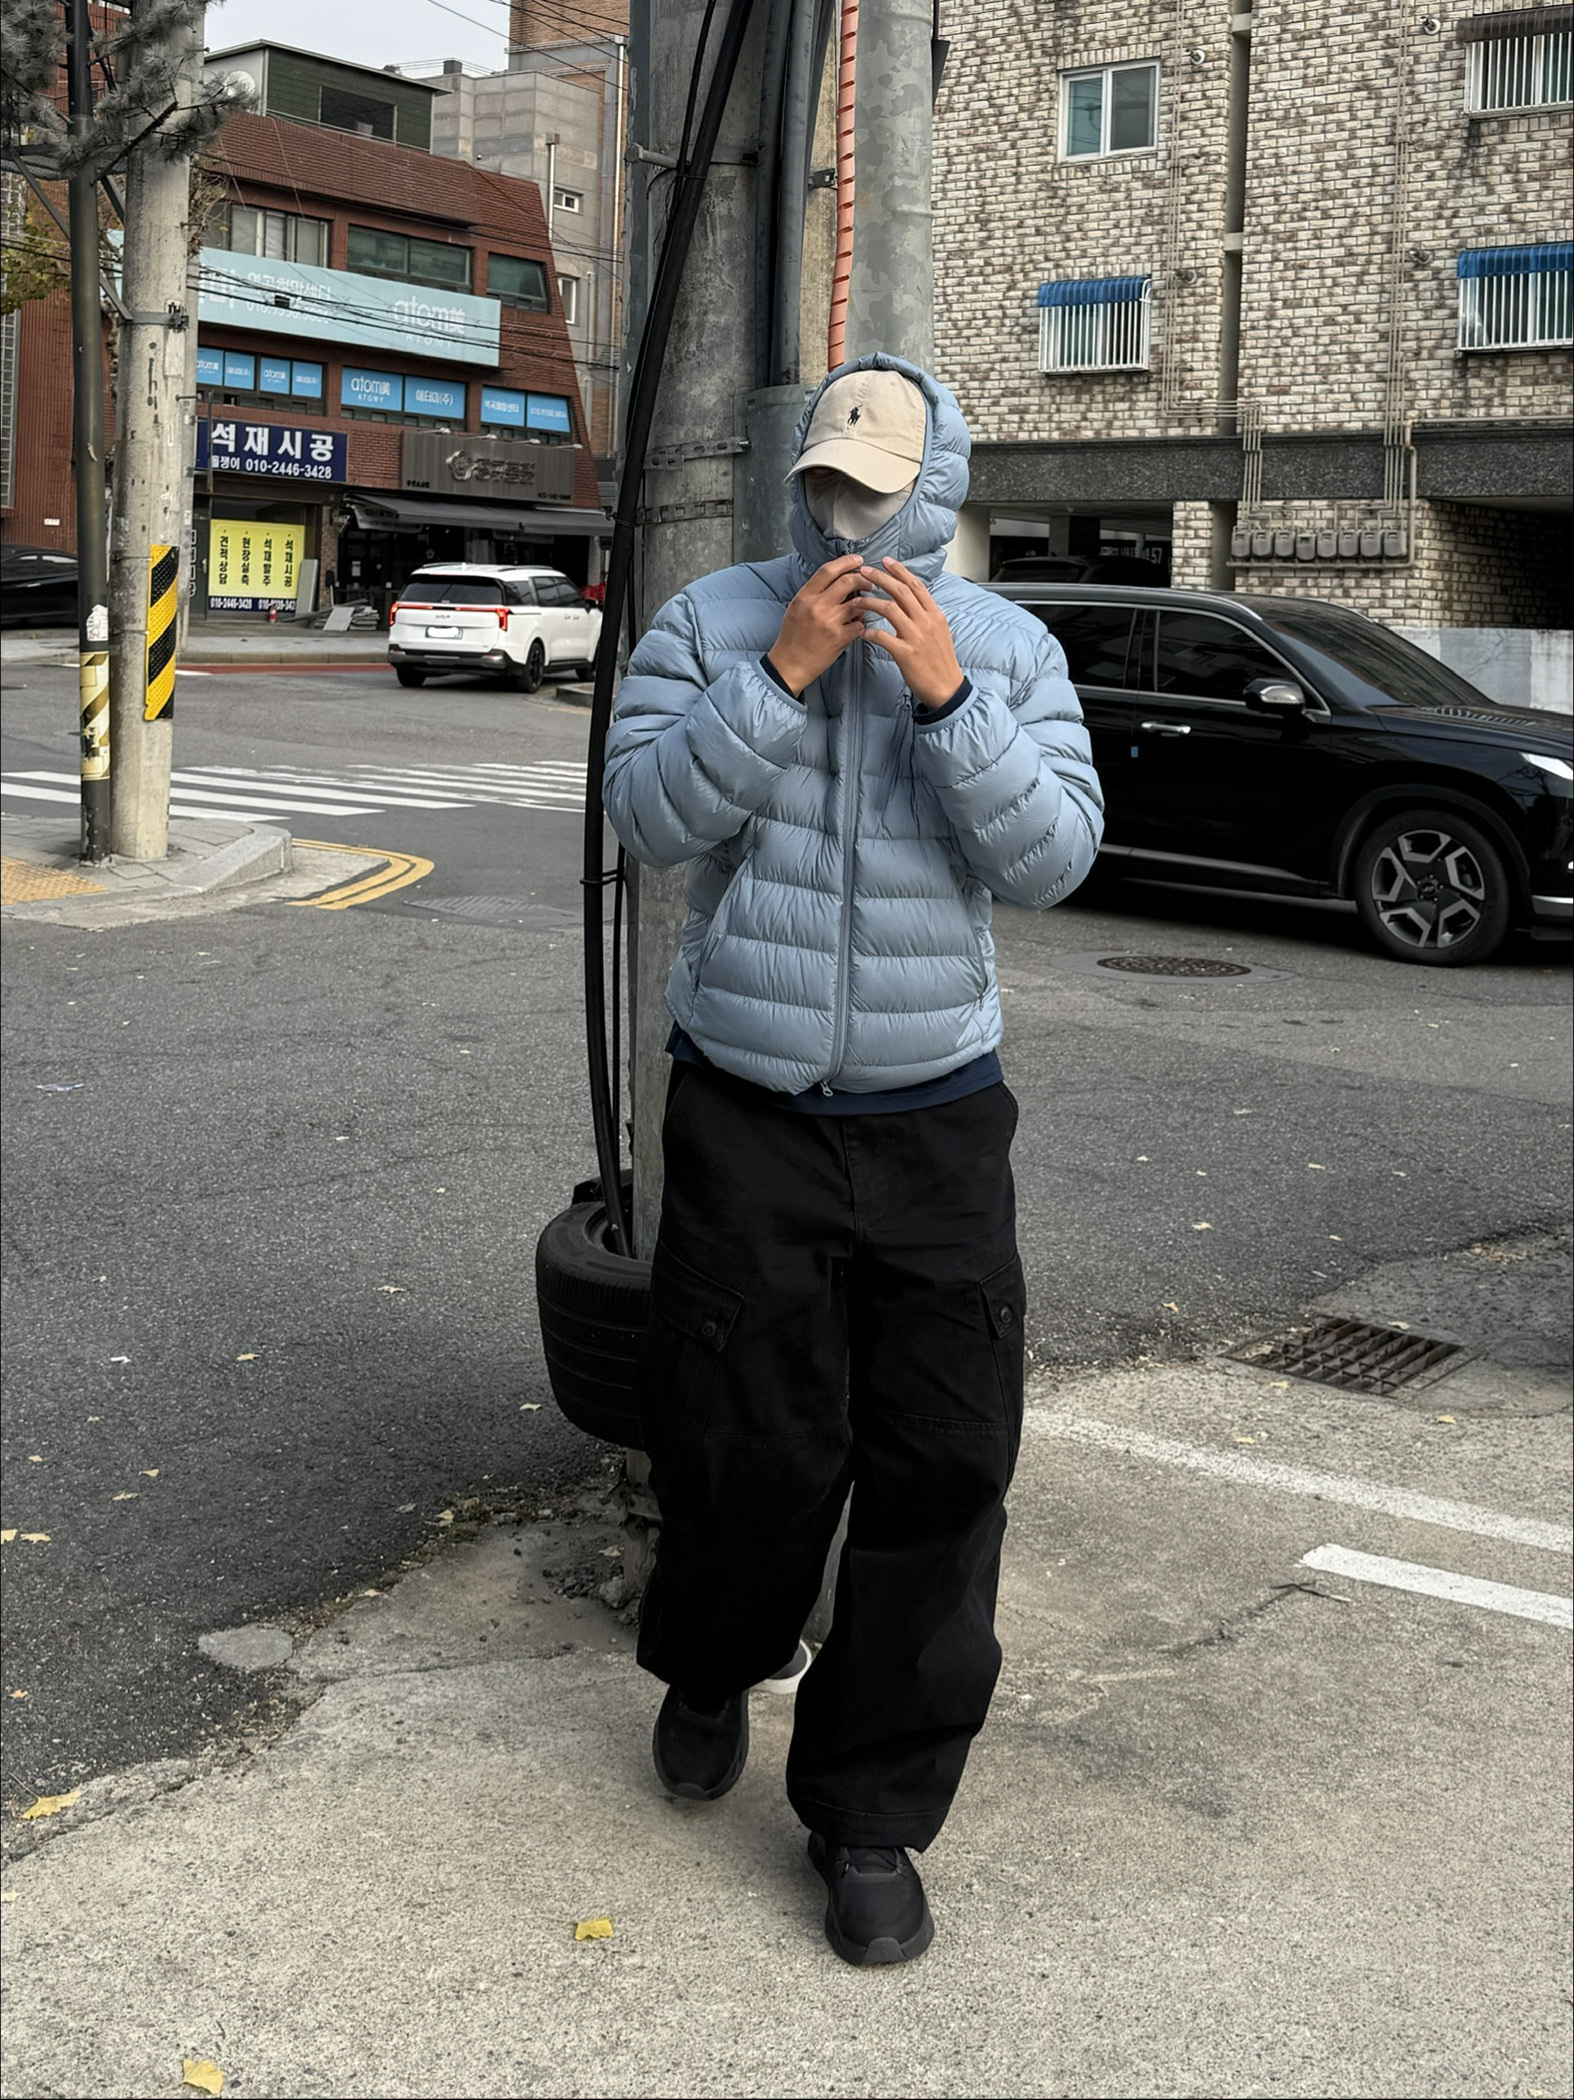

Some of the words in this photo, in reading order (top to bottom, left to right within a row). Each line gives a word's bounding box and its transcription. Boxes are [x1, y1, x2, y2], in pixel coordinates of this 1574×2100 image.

[211, 422, 334, 462] 석재시공
[245, 458, 333, 479] 010-2446-3428
[218, 535, 229, 585] 견적상담
[283, 539, 294, 588] 석재시공
